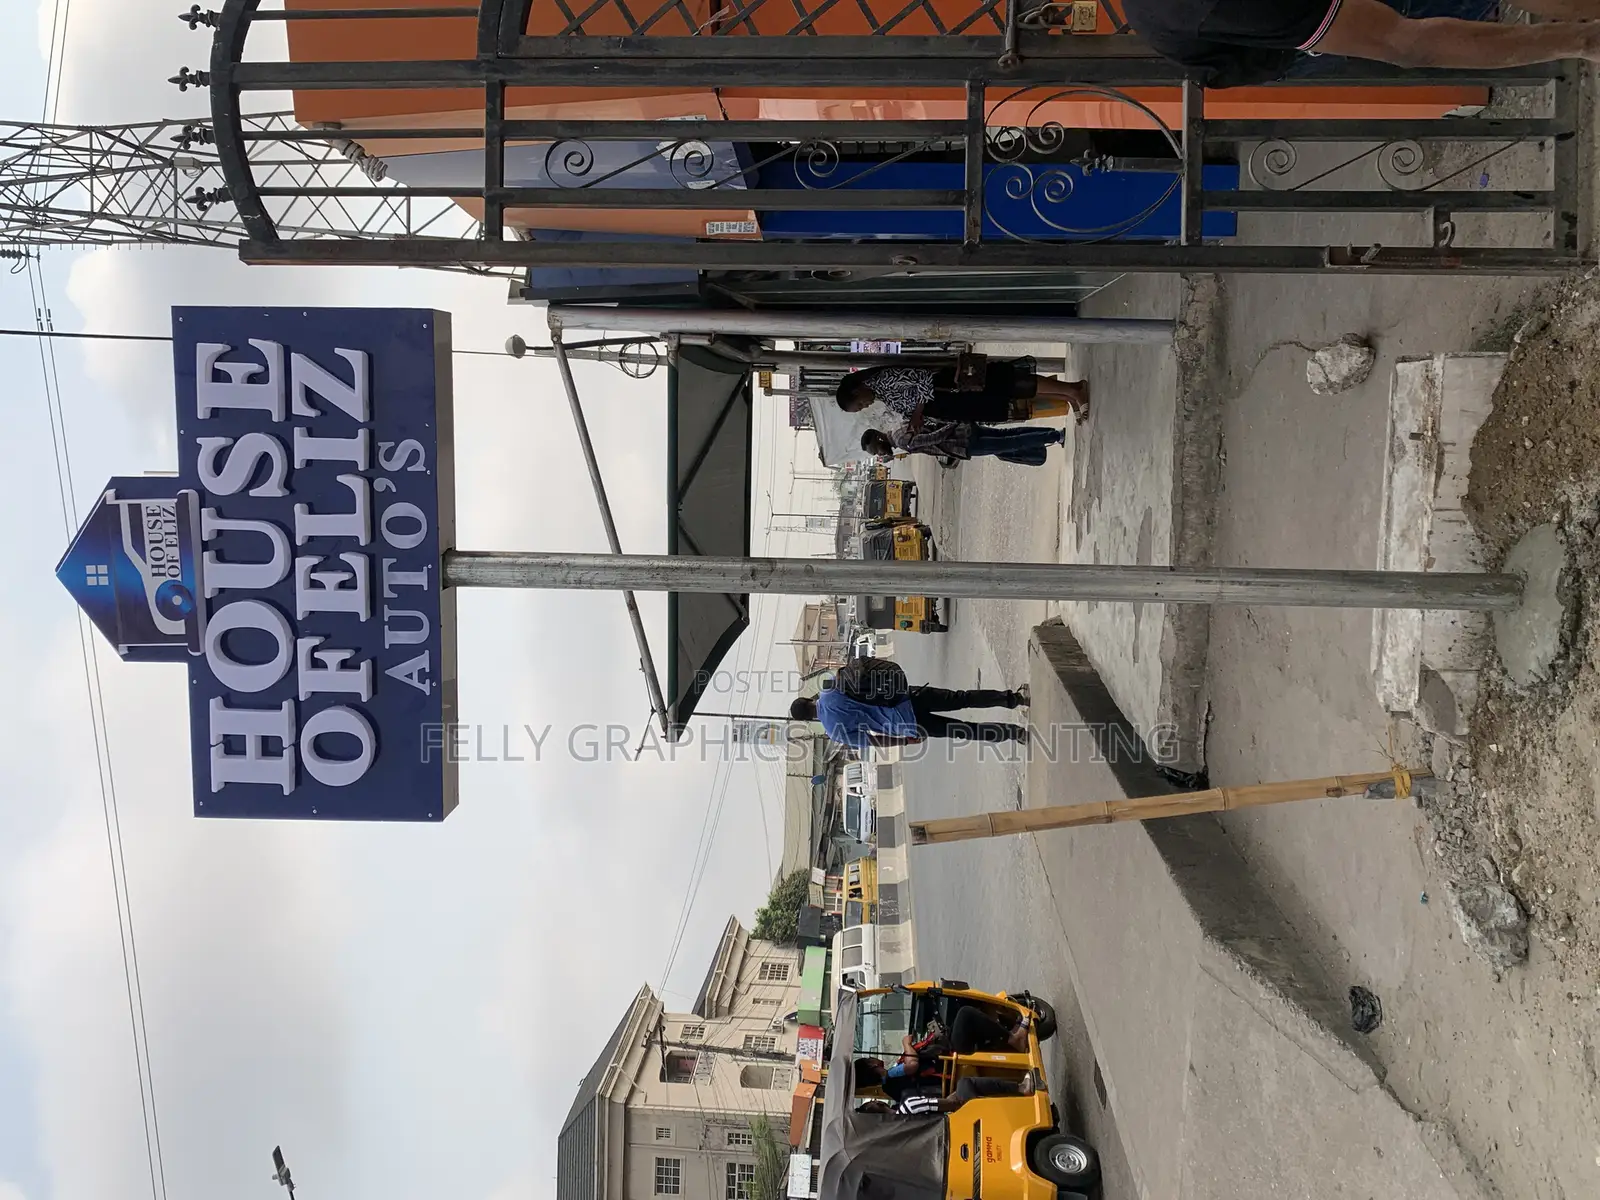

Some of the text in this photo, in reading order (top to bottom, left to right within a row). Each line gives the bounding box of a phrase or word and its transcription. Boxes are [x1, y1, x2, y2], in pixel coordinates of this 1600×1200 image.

[145, 504, 167, 579] HOUSE
[162, 505, 181, 578] OF ELIZ
[196, 338, 296, 796] HOUSE
[291, 347, 377, 787] OF ELIZ
[373, 438, 431, 696] AUTO'S
